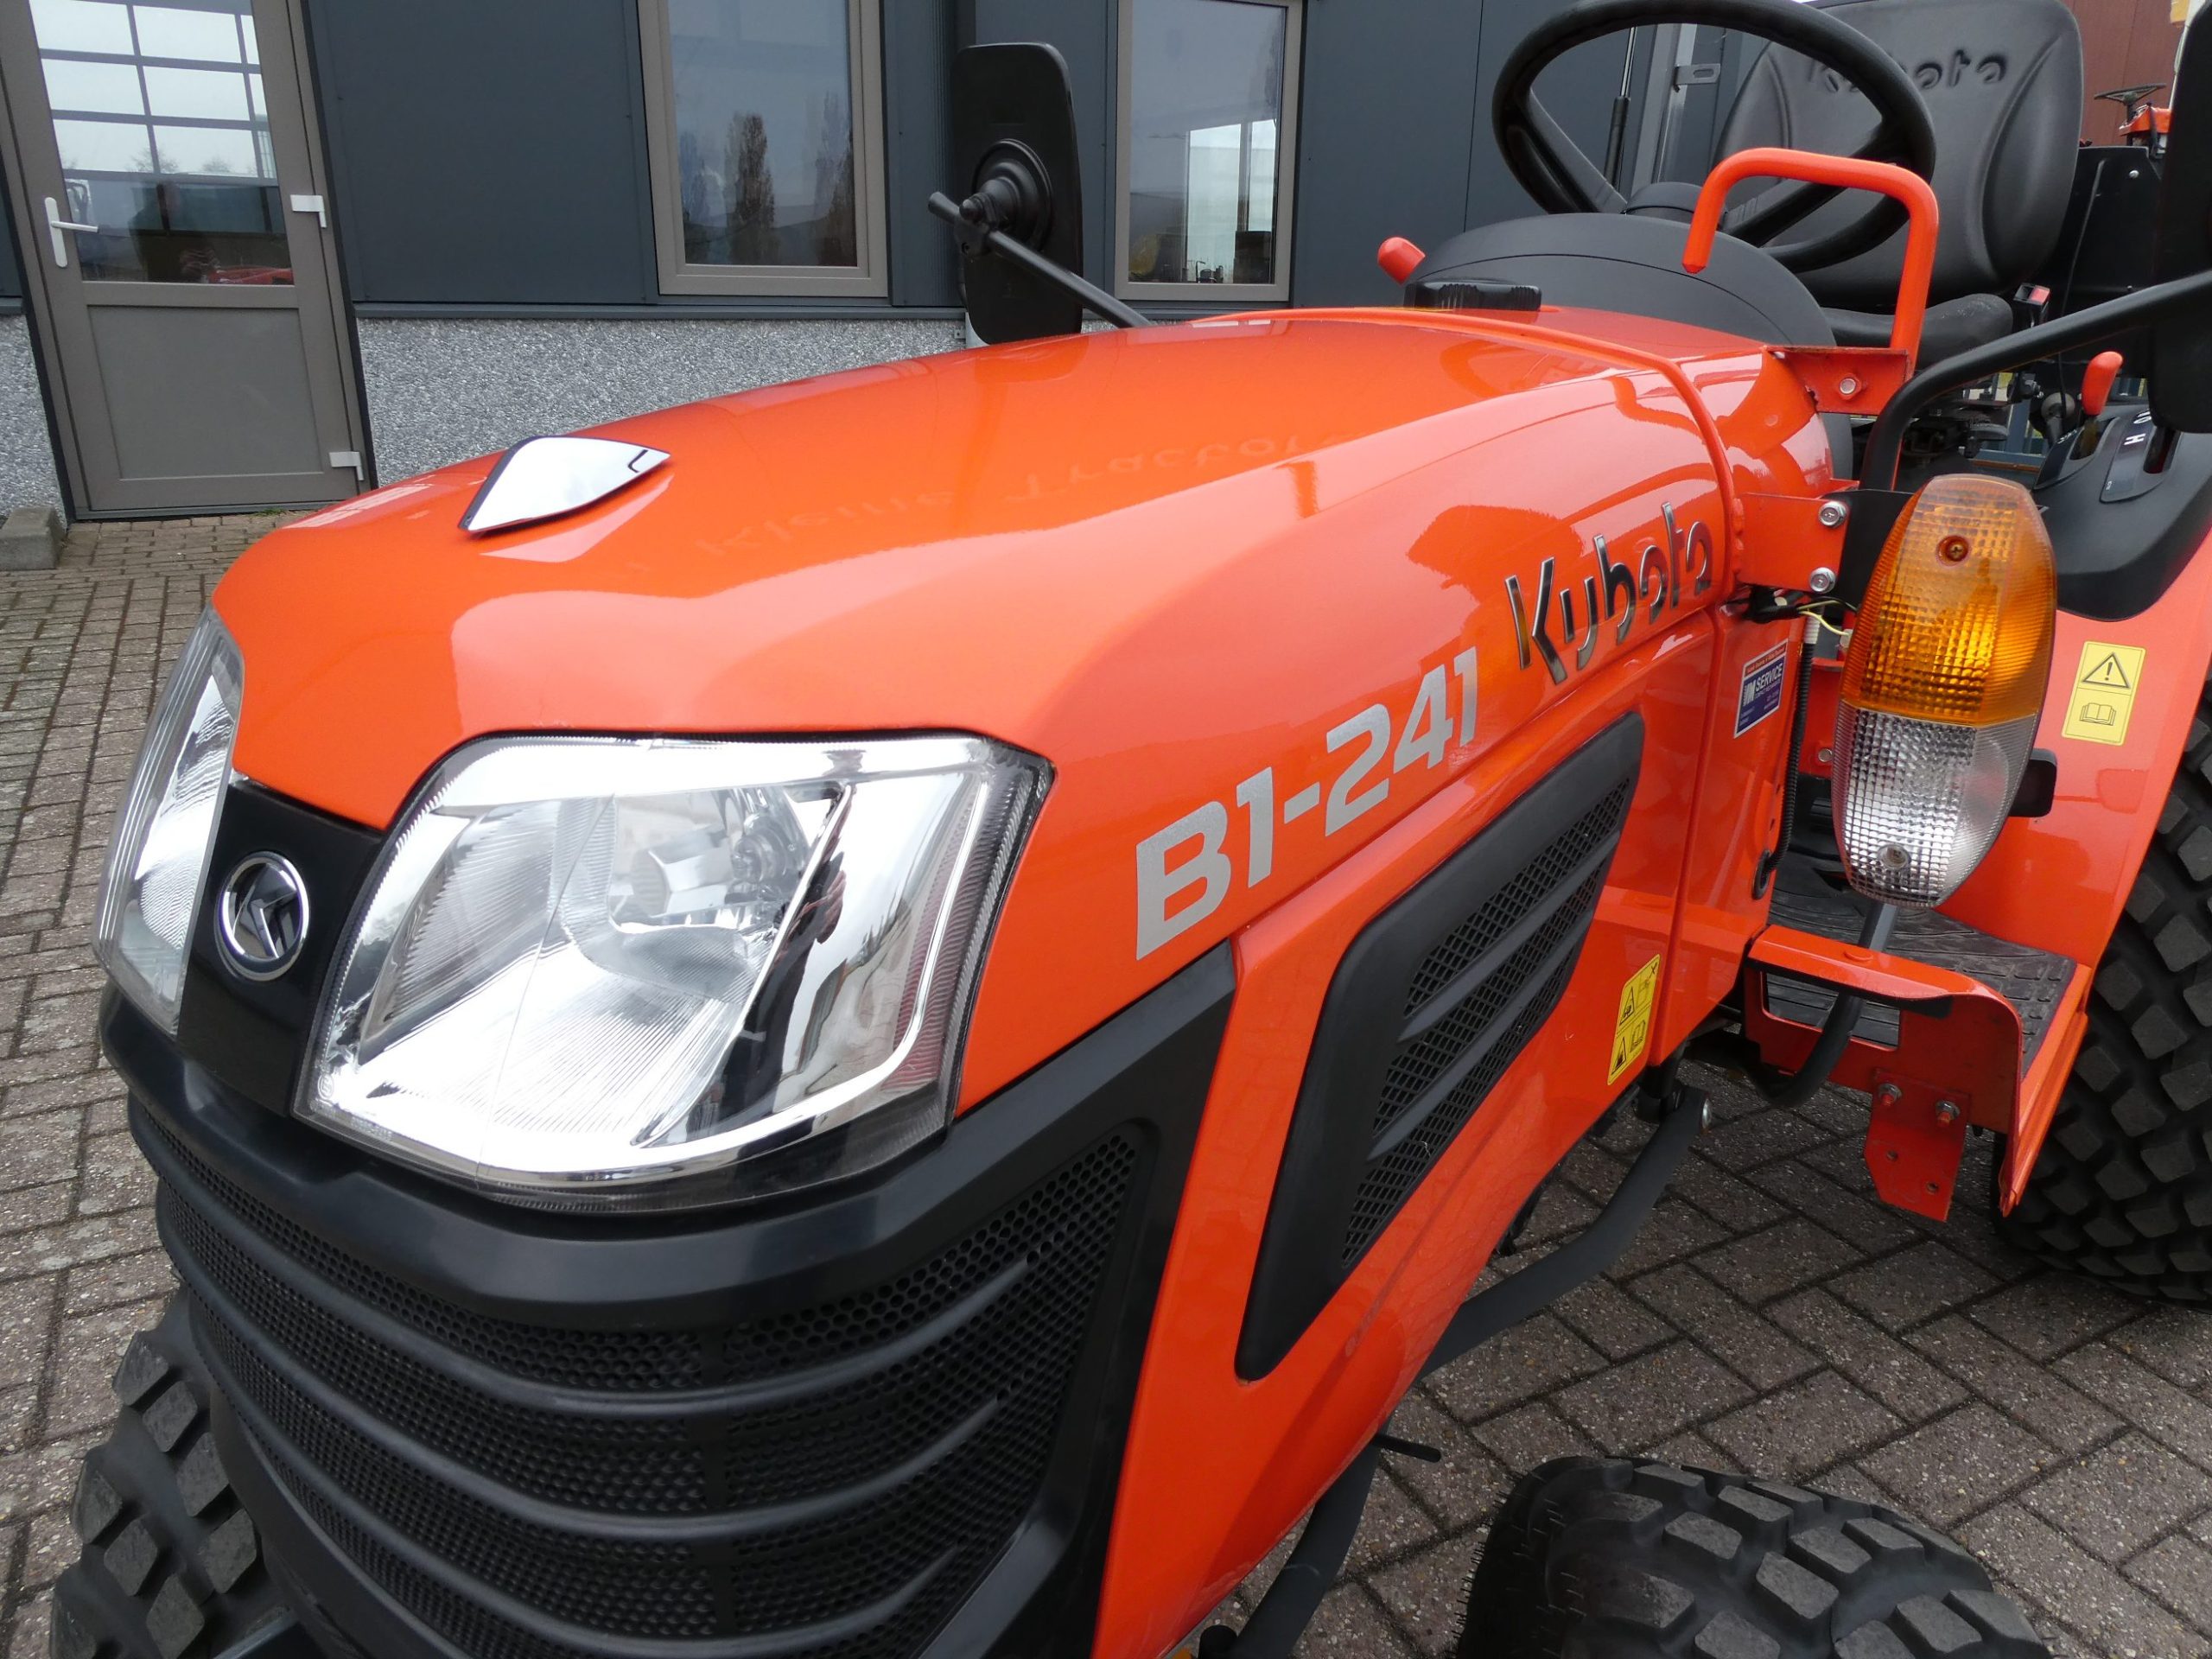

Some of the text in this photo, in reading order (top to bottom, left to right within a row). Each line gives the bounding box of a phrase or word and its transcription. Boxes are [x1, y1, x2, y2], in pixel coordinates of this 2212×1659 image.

[1504, 501, 1713, 685] Kubota
[1756, 663, 1783, 692] SERVICE
[1136, 646, 1478, 961] B1-241
